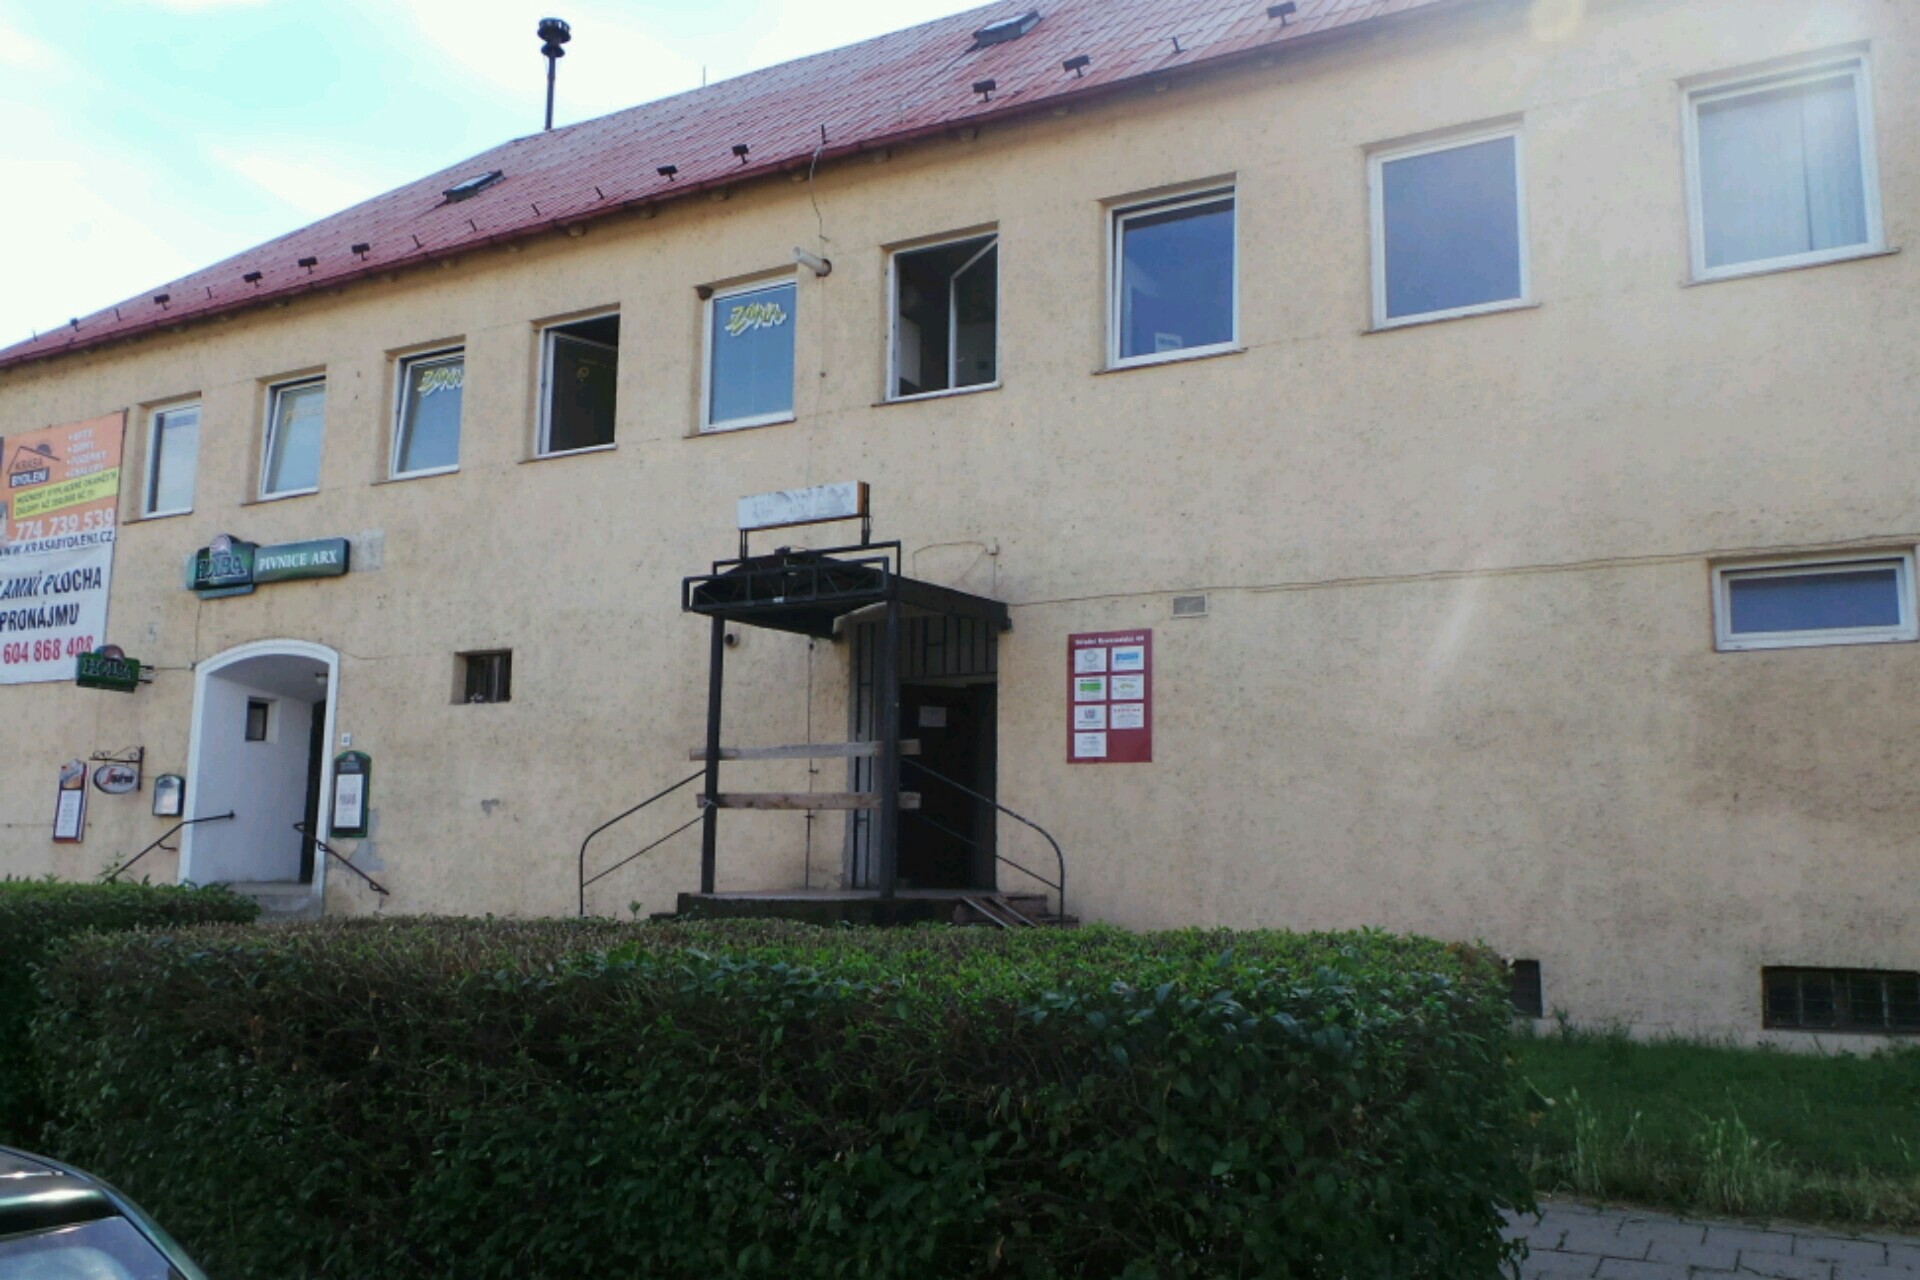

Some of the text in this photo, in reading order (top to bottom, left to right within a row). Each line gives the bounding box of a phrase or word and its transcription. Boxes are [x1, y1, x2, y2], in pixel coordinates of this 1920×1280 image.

[49, 514, 79, 535] 739
[83, 508, 114, 530] 539
[258, 552, 307, 571] PIVNICE
[311, 550, 338, 565] ARX
[43, 566, 102, 595] PLOCHA
[0, 601, 80, 632] PRONÁJMU
[3, 635, 94, 664] 604 868 408
